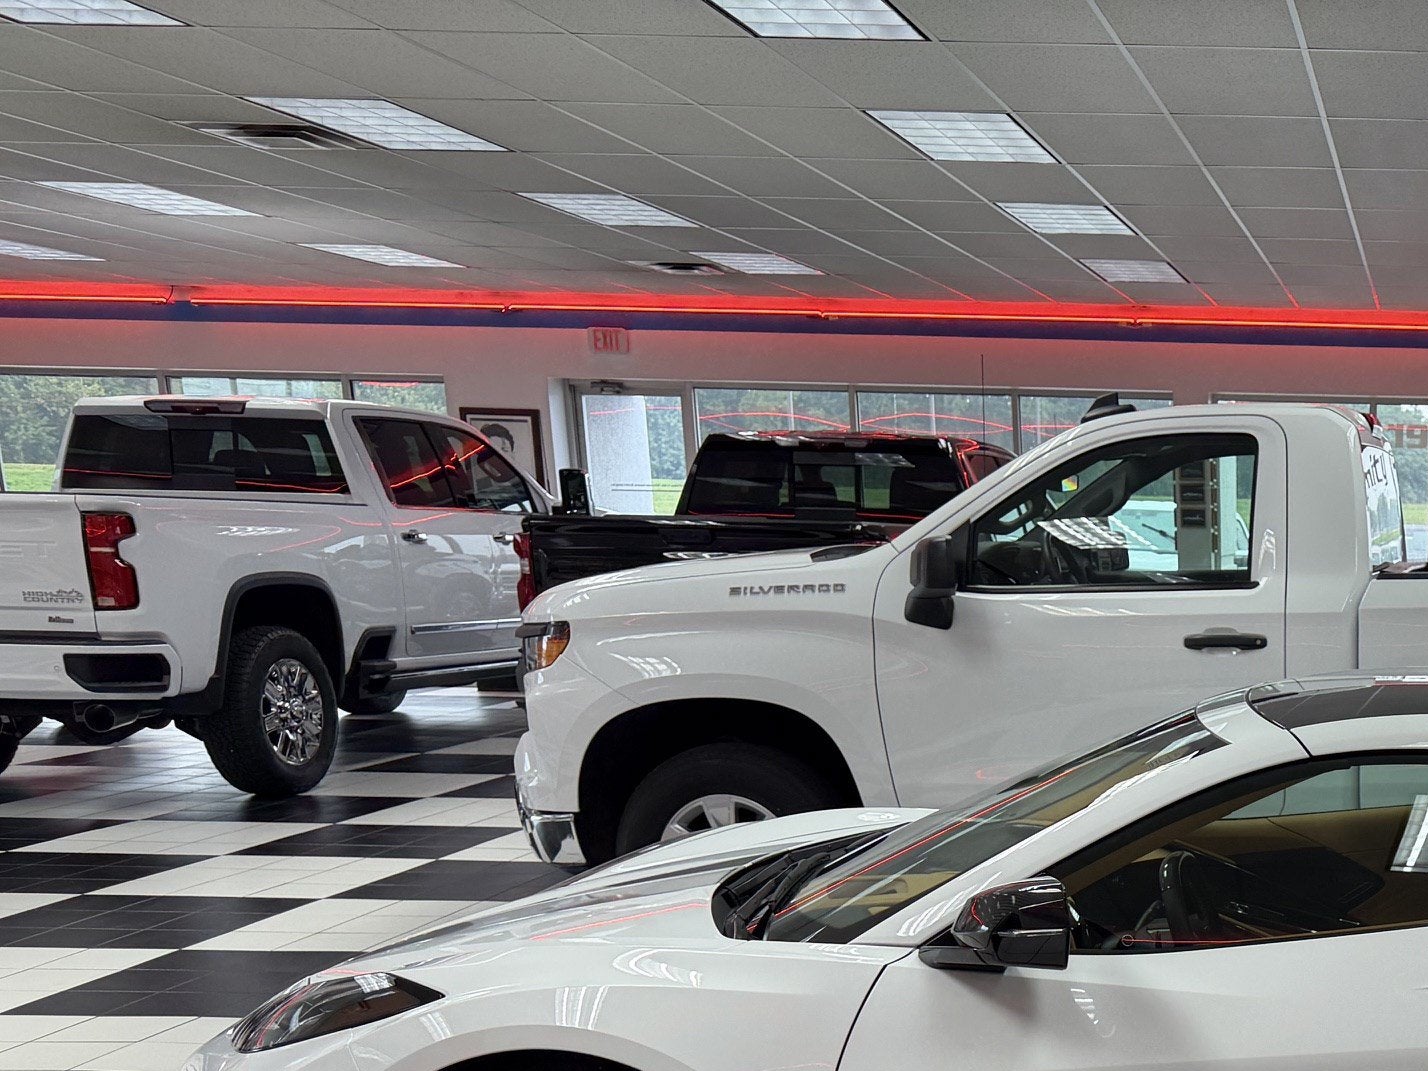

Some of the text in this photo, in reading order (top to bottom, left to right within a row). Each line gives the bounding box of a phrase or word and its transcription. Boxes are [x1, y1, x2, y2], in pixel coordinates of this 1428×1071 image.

[593, 329, 620, 351] EXIT
[729, 583, 847, 596] SILVERADO
[23, 596, 84, 604] COUNTRY
